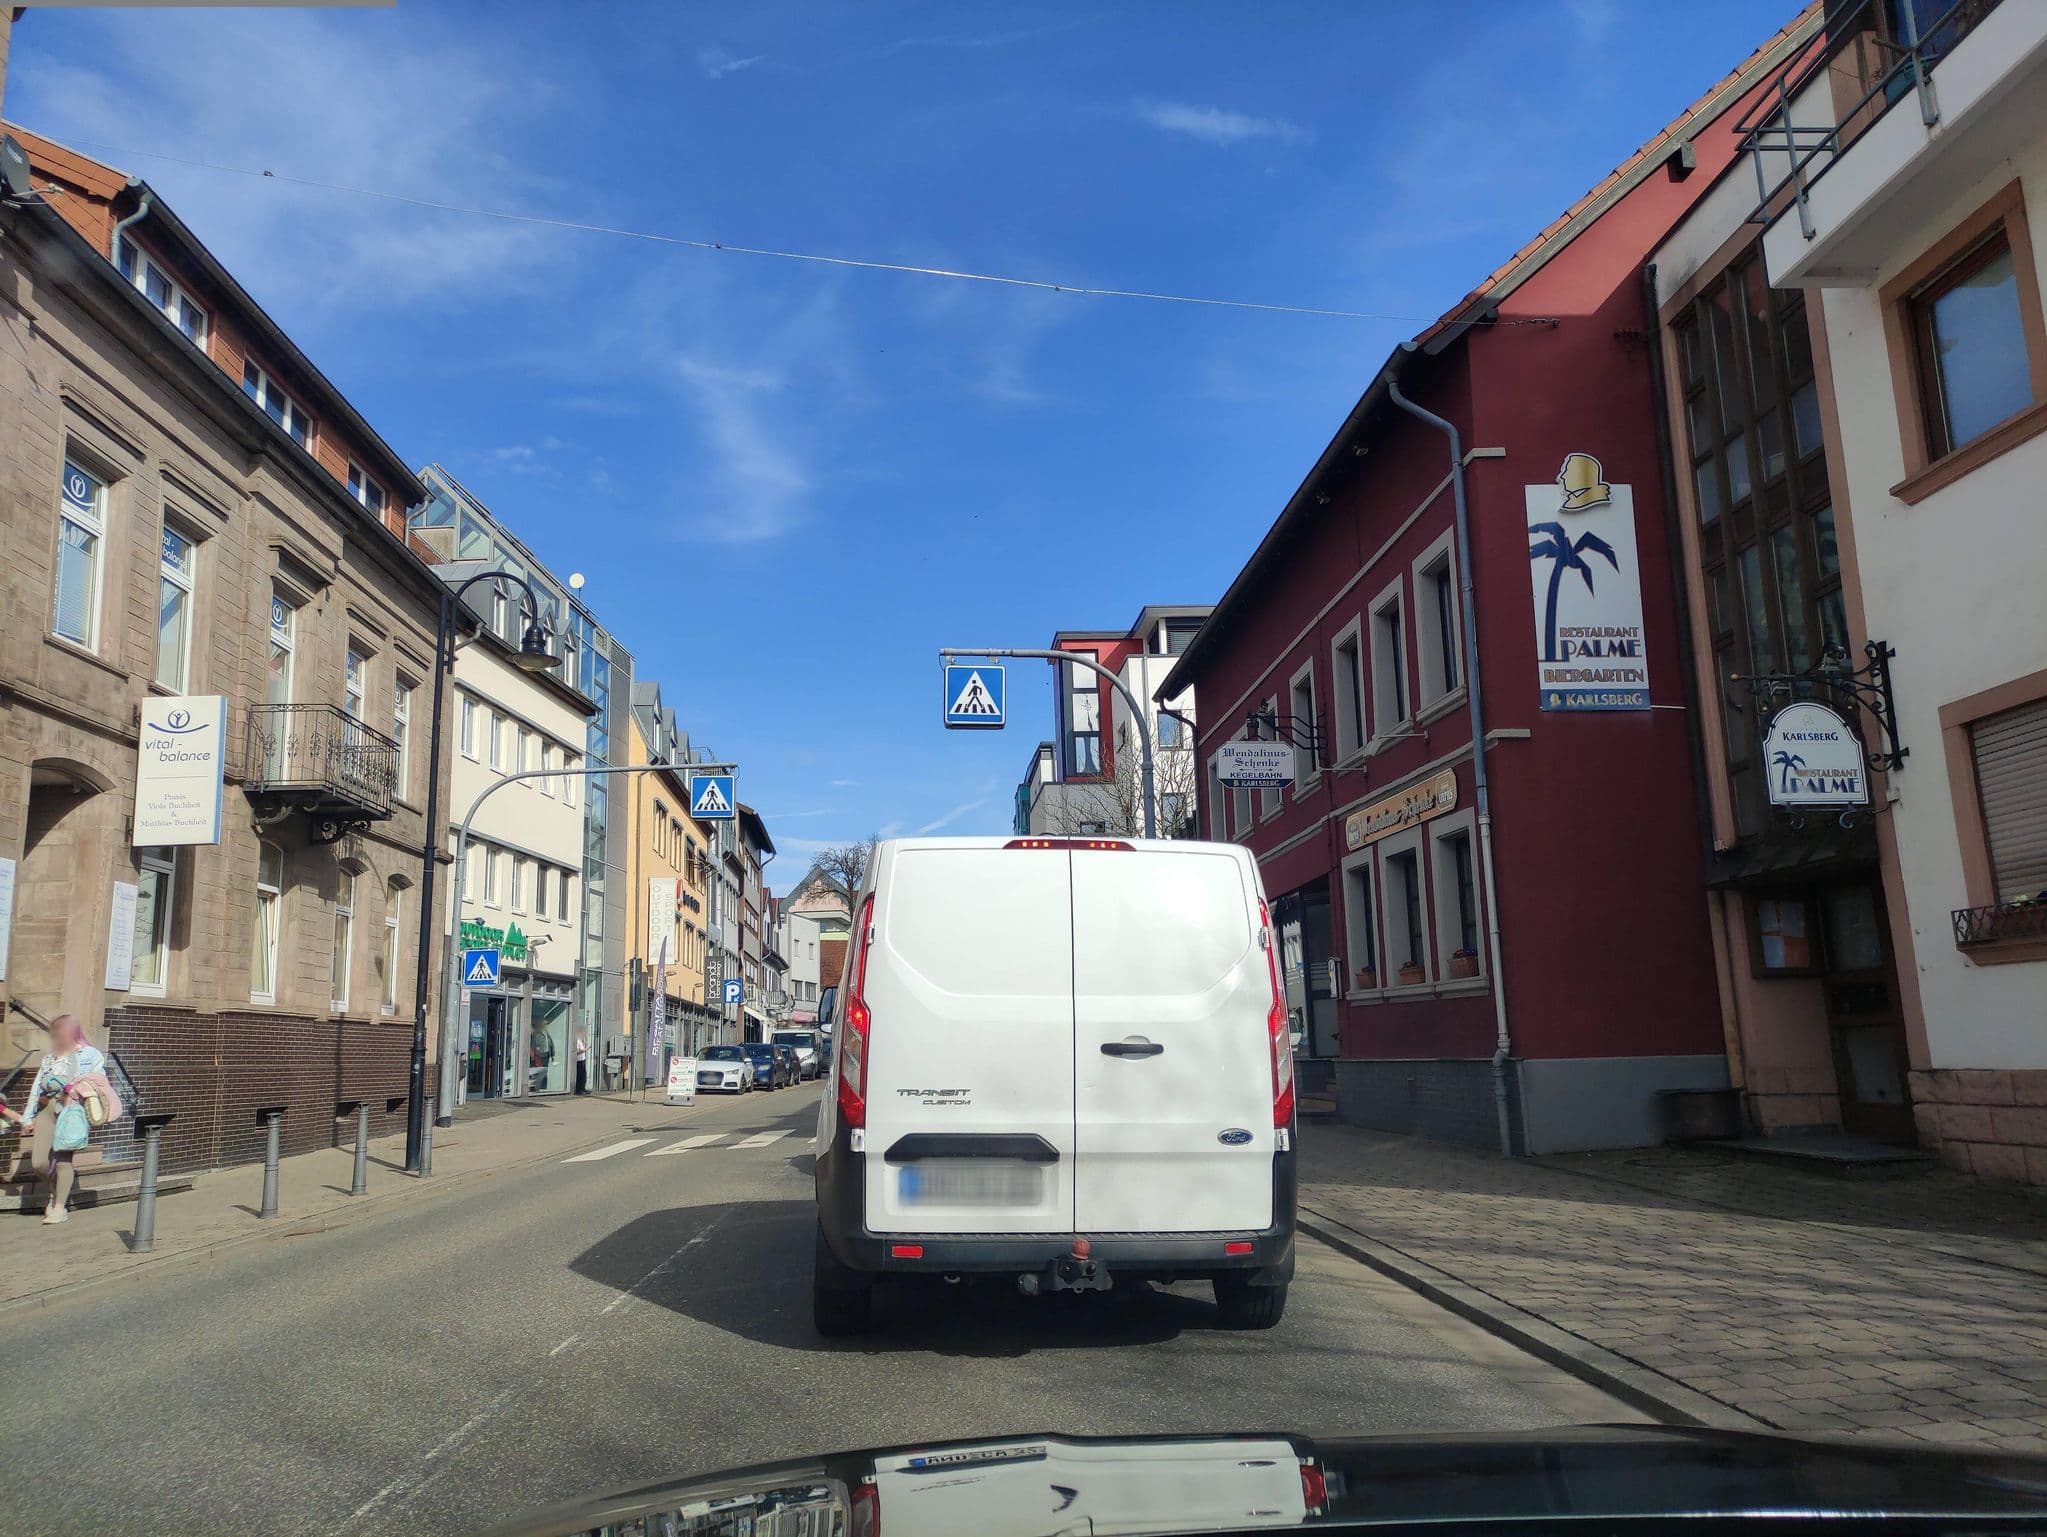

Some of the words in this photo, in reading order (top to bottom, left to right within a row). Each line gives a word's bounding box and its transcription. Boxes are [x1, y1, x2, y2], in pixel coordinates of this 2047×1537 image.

[1559, 626, 1640, 638] RESTAURANT
[1559, 639, 1643, 662] PALME
[1544, 669, 1643, 682] BIERGARTEN
[1565, 692, 1643, 706] KARLSBERG
[1783, 732, 1838, 741] KARLSBERG
[145, 737, 175, 750] vital
[159, 750, 212, 762] balance
[1231, 757, 1281, 769] Schenke
[1797, 769, 1858, 778] STAURANT
[1791, 778, 1860, 793] PALME
[664, 893, 674, 932] SPORT
[706, 961, 717, 999] brandt
[896, 1089, 972, 1097] TRANSIT
[1226, 1132, 1247, 1142] Ford
